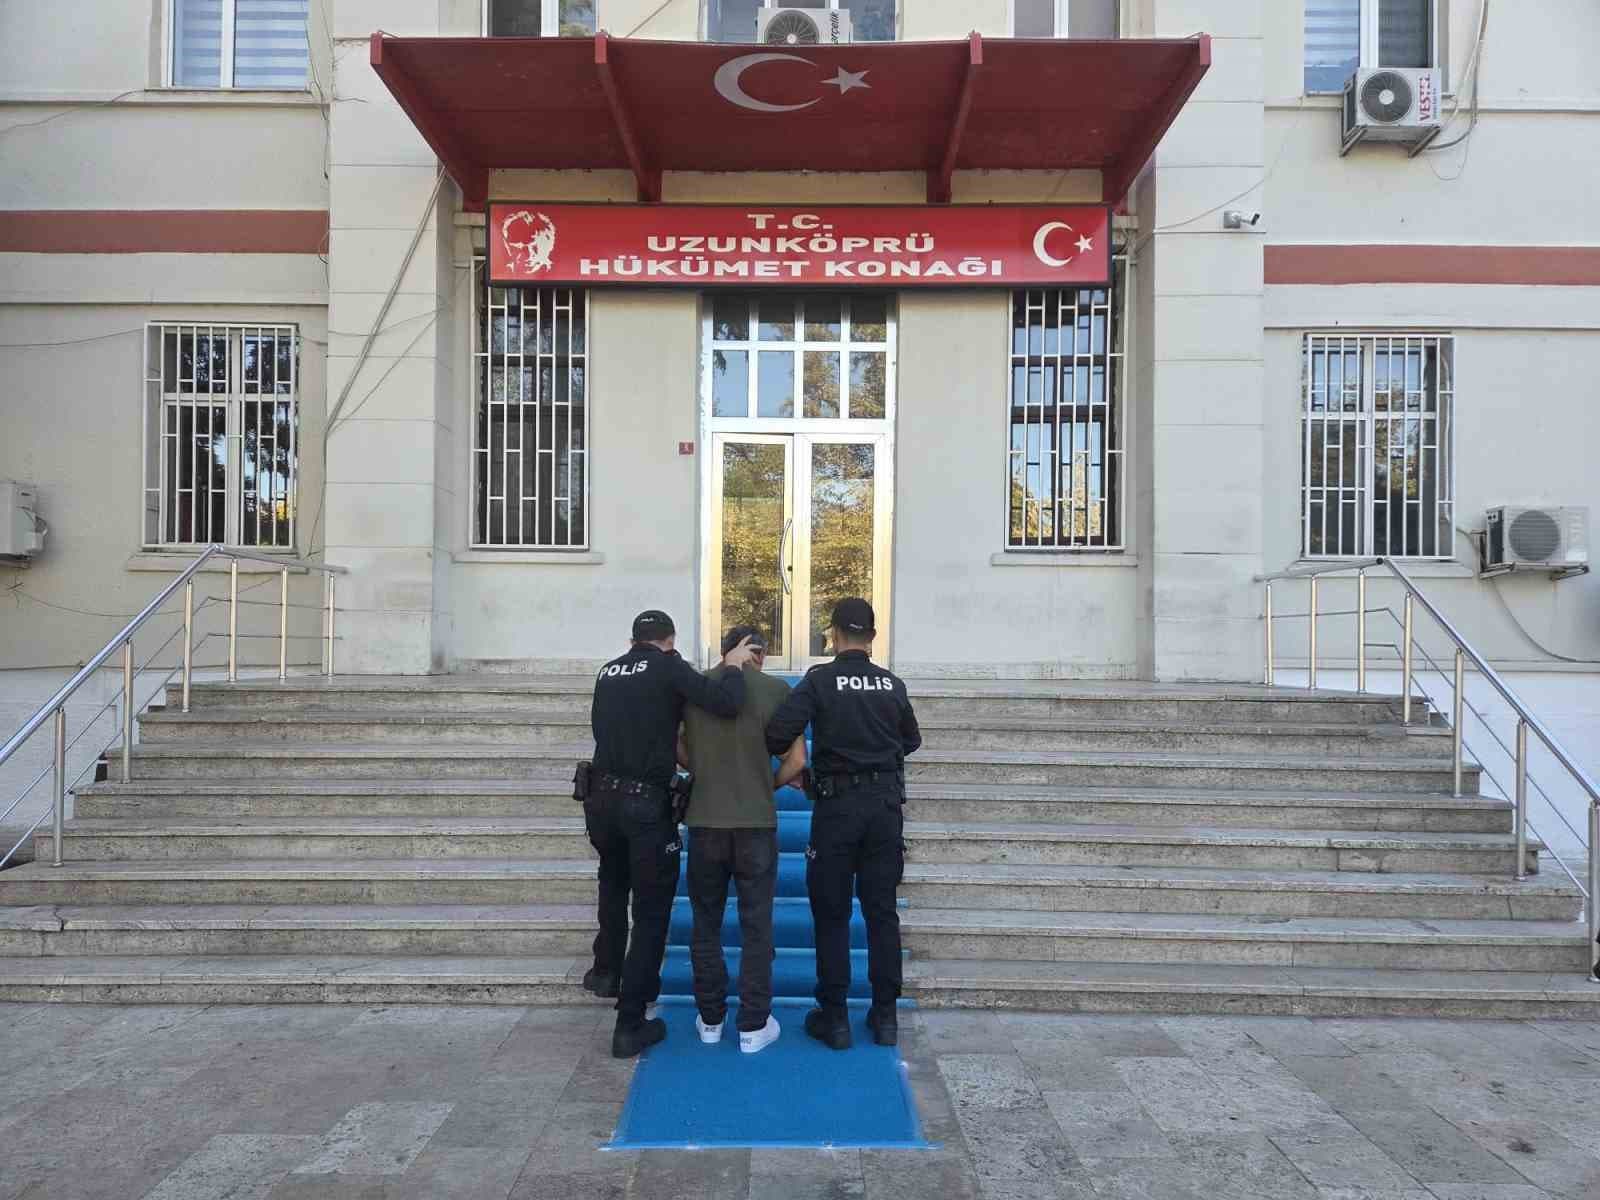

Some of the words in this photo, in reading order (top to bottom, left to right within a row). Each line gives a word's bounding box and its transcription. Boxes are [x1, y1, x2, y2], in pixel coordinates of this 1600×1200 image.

[1419, 73, 1431, 121] VESTEL
[747, 213, 833, 230] T.C.
[647, 232, 935, 253] UZUNKÖPRÜ
[579, 255, 810, 276] HÜKÜMET
[824, 256, 1003, 277] KONAĞI
